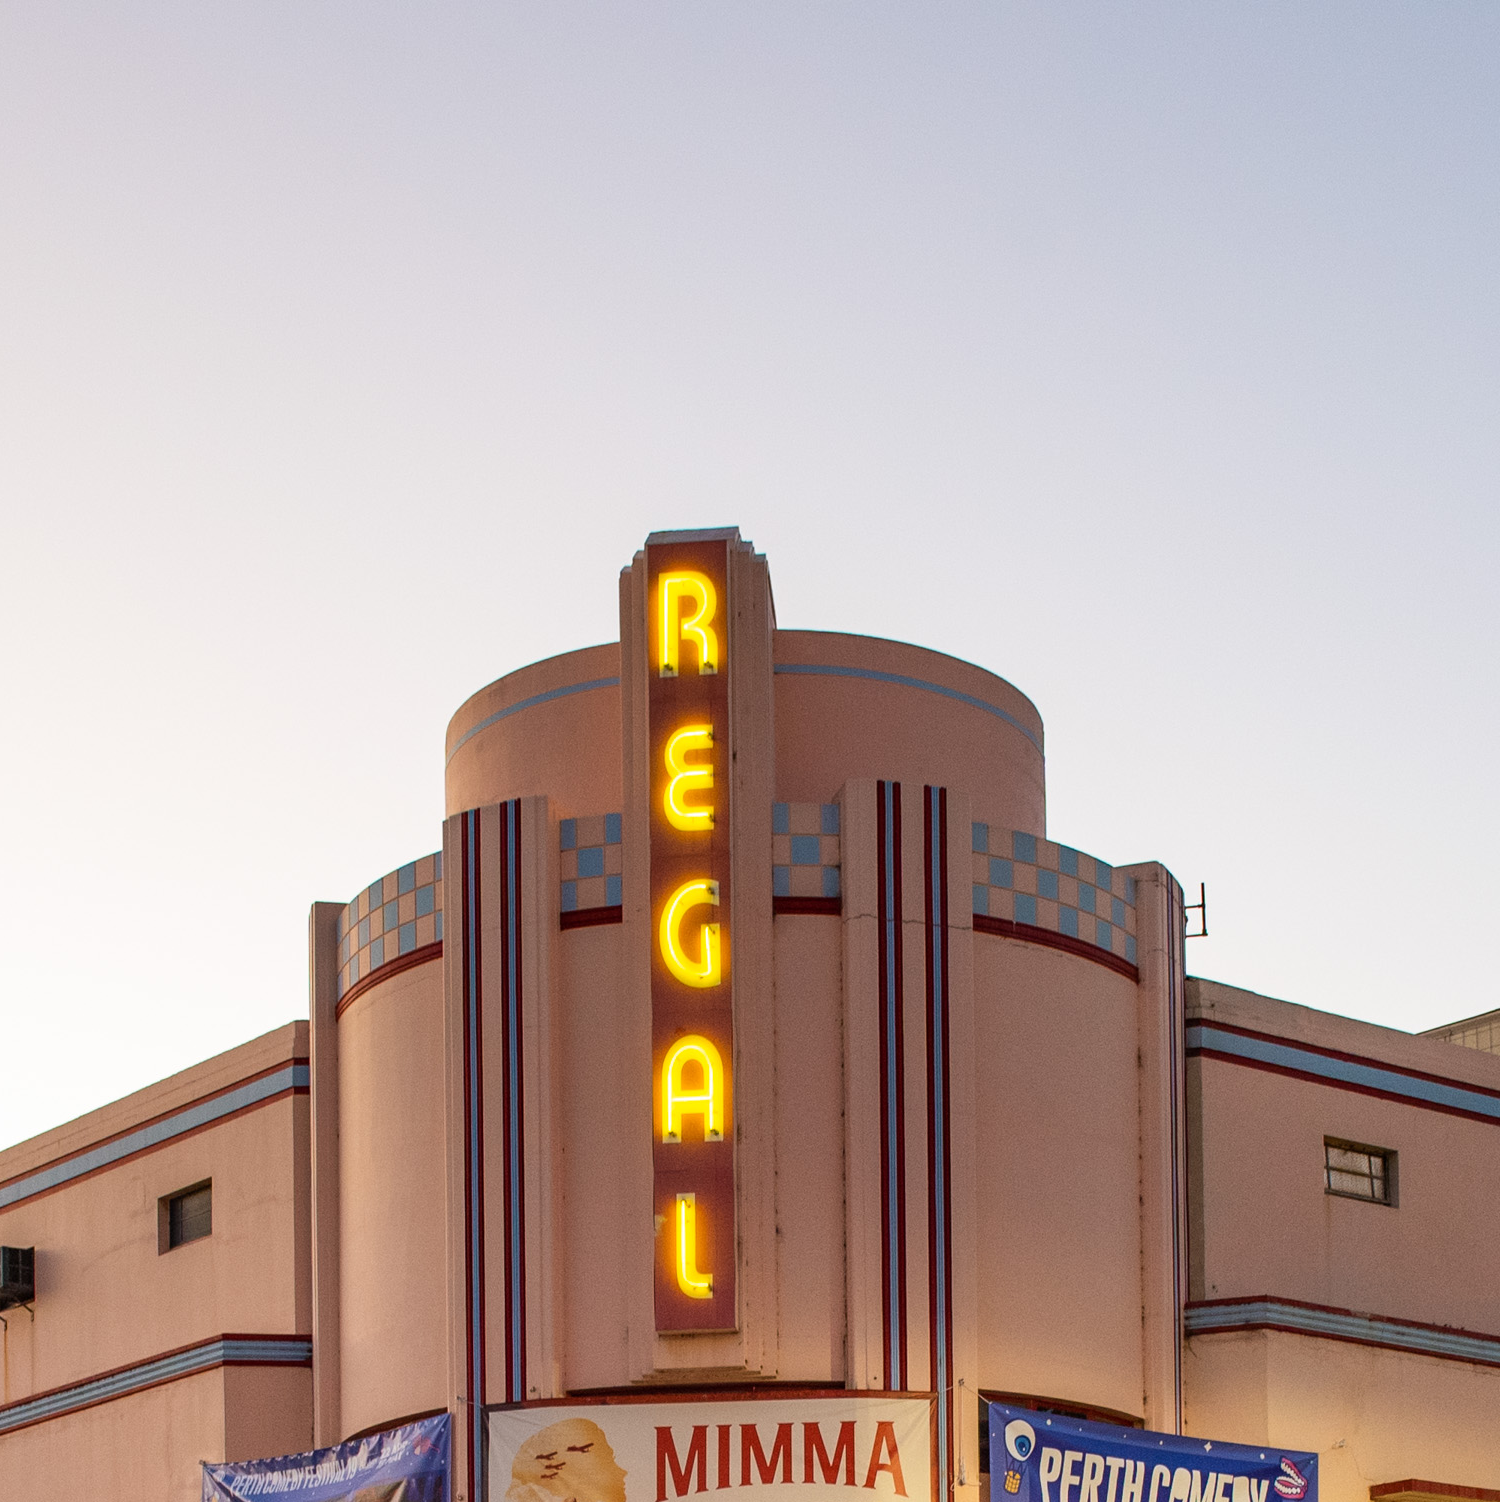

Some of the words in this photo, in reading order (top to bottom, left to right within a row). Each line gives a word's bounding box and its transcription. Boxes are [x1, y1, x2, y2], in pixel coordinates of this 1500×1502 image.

[655, 570, 725, 1301] REGAL
[230, 1472, 264, 1496] PERTH
[263, 1468, 304, 1494] COMEDY
[654, 1420, 909, 1502] MIMMA
